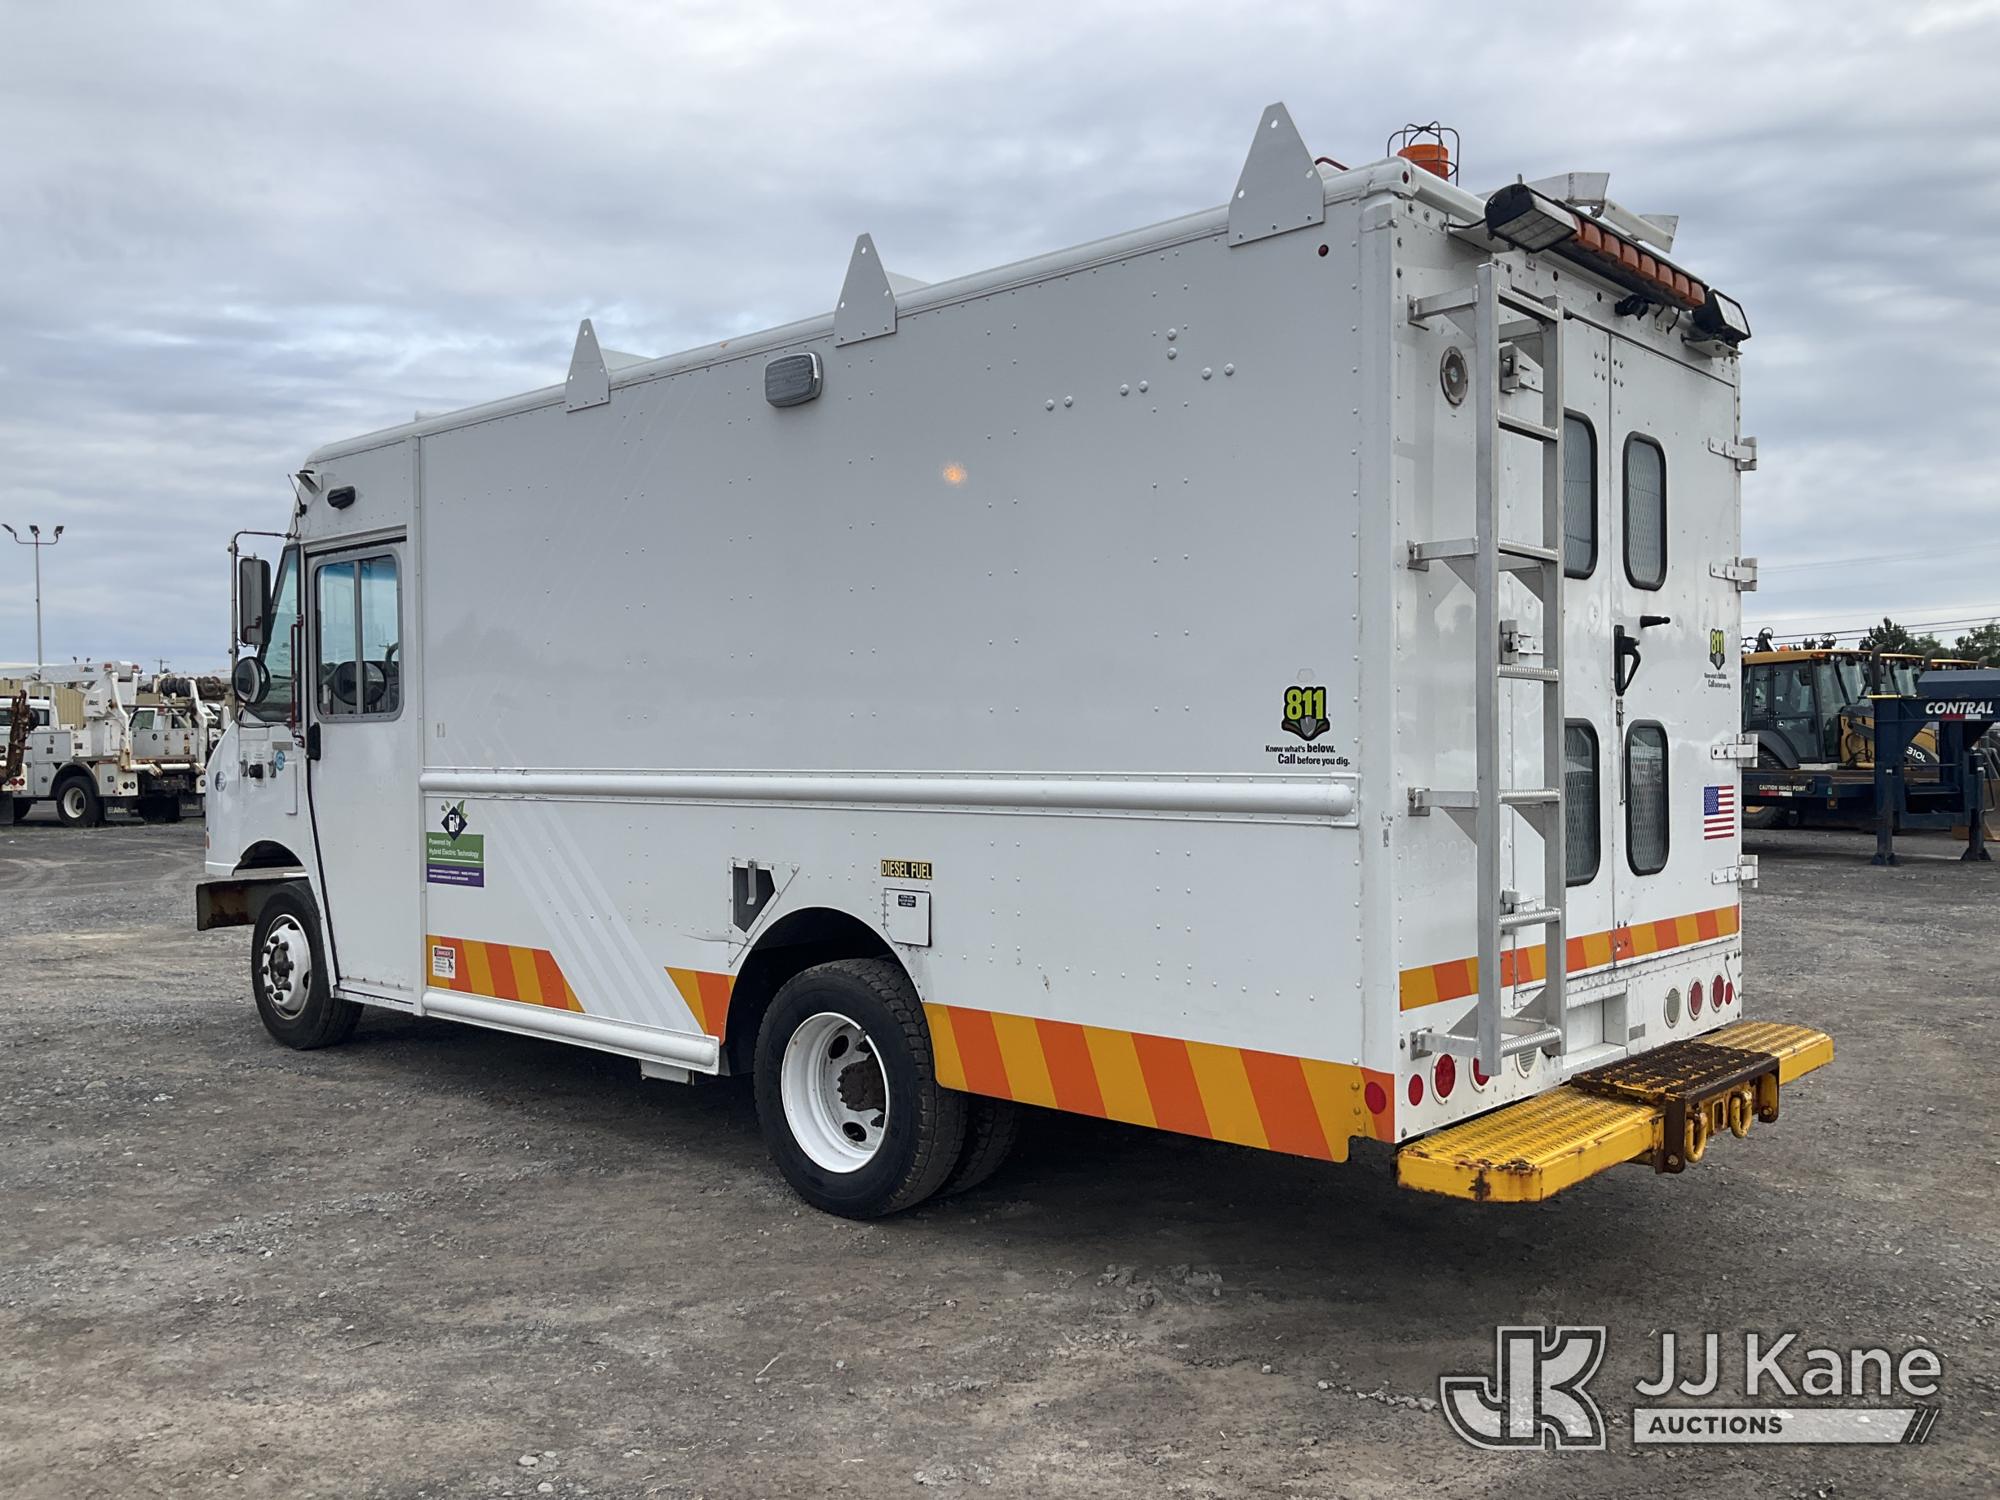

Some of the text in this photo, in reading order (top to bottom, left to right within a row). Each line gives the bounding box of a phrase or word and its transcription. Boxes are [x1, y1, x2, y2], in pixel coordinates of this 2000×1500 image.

[1711, 630, 1724, 655] 811
[1285, 687, 1325, 720] 811
[1925, 701, 1994, 715] CONTRAL
[1265, 743, 1336, 754] Know what's below.
[1906, 746, 1927, 763] 310L
[1277, 753, 1351, 767] Call before you dig.
[882, 861, 932, 879] DIESEL FUEL
